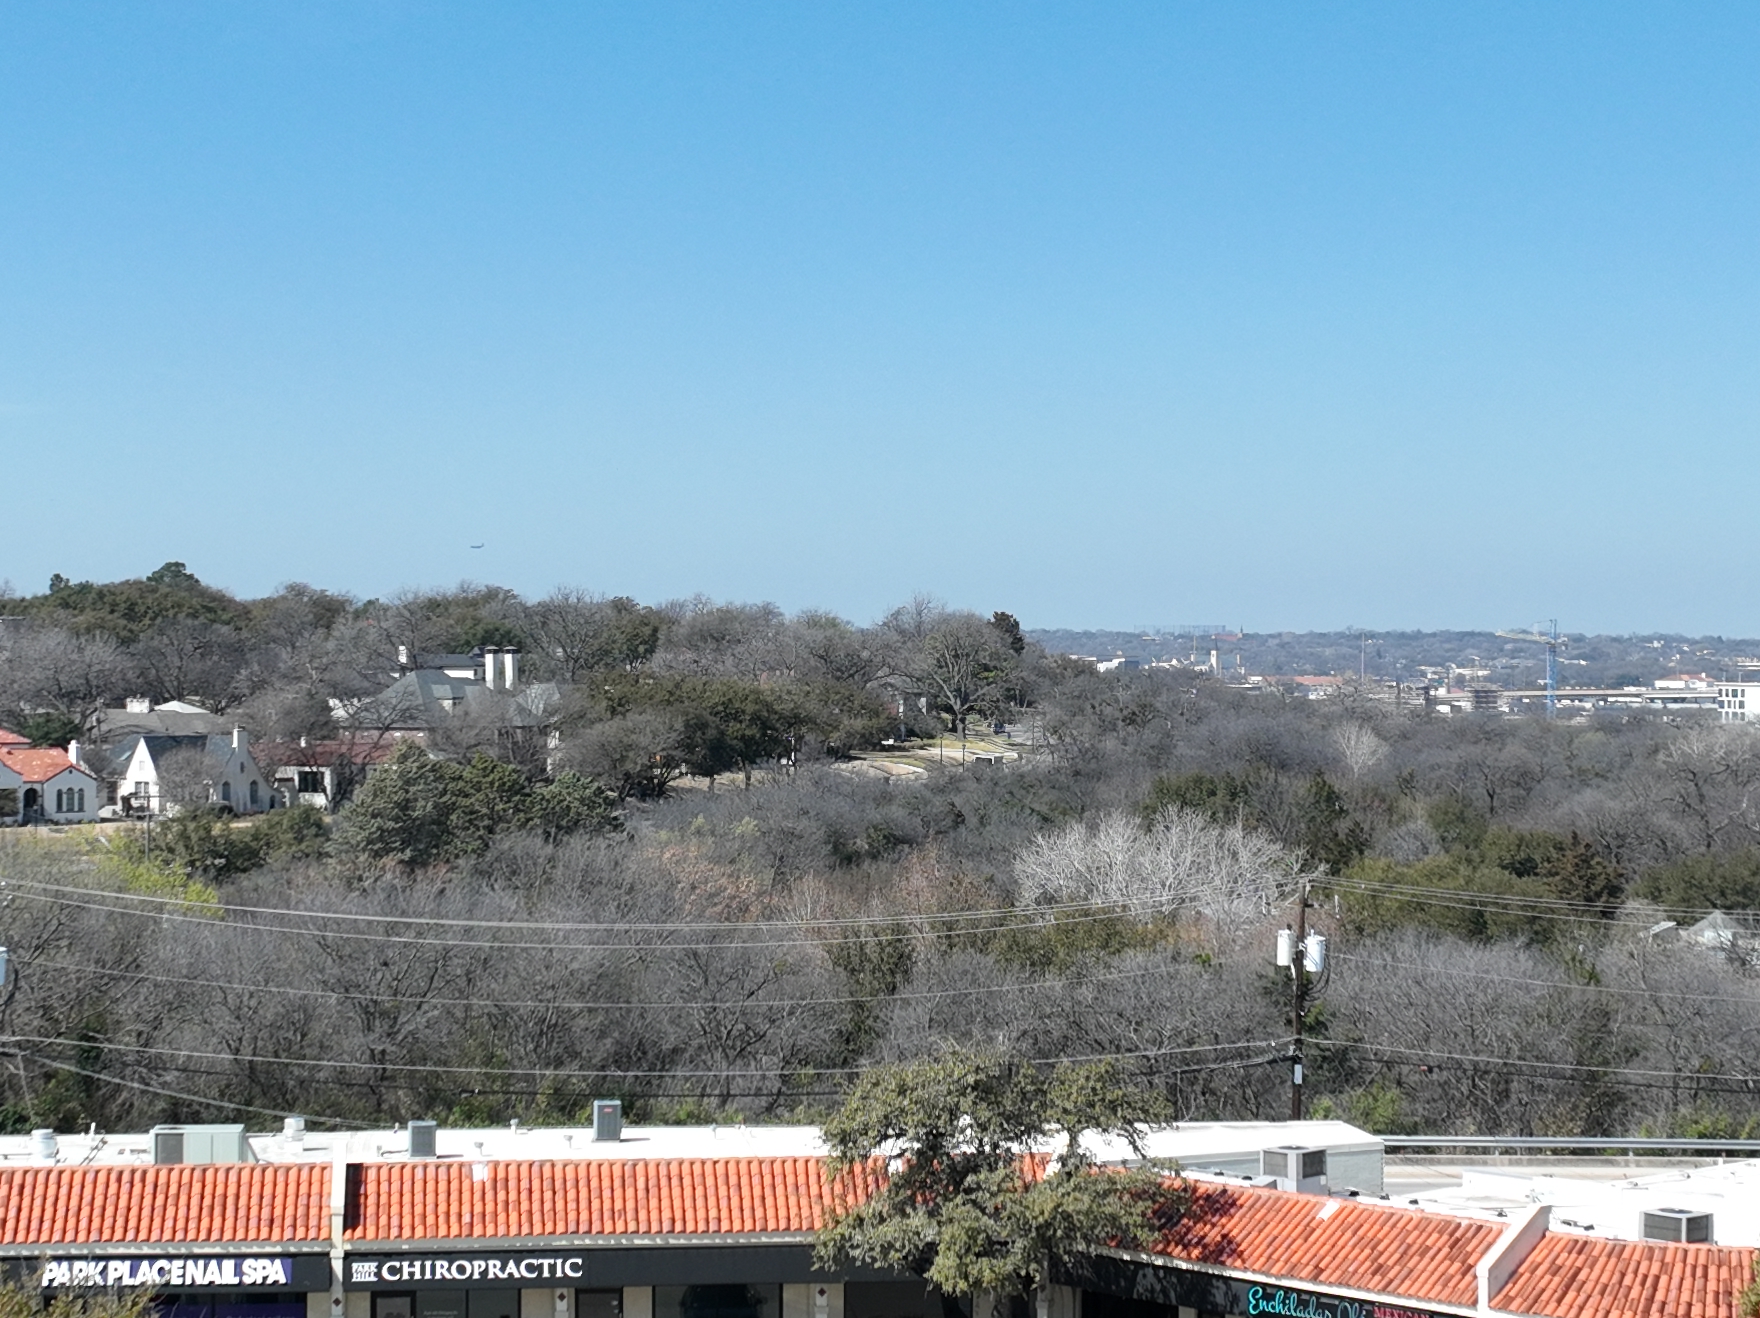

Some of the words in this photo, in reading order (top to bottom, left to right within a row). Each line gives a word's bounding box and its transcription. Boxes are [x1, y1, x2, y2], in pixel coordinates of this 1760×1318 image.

[41, 1260, 106, 1287] PARK
[107, 1259, 184, 1286] PLACE
[185, 1257, 241, 1285] NAIL
[241, 1258, 287, 1285] SPA
[351, 1262, 379, 1272] PARK
[381, 1257, 583, 1281] CHIROPRACTIC
[351, 1271, 379, 1282] HILL
